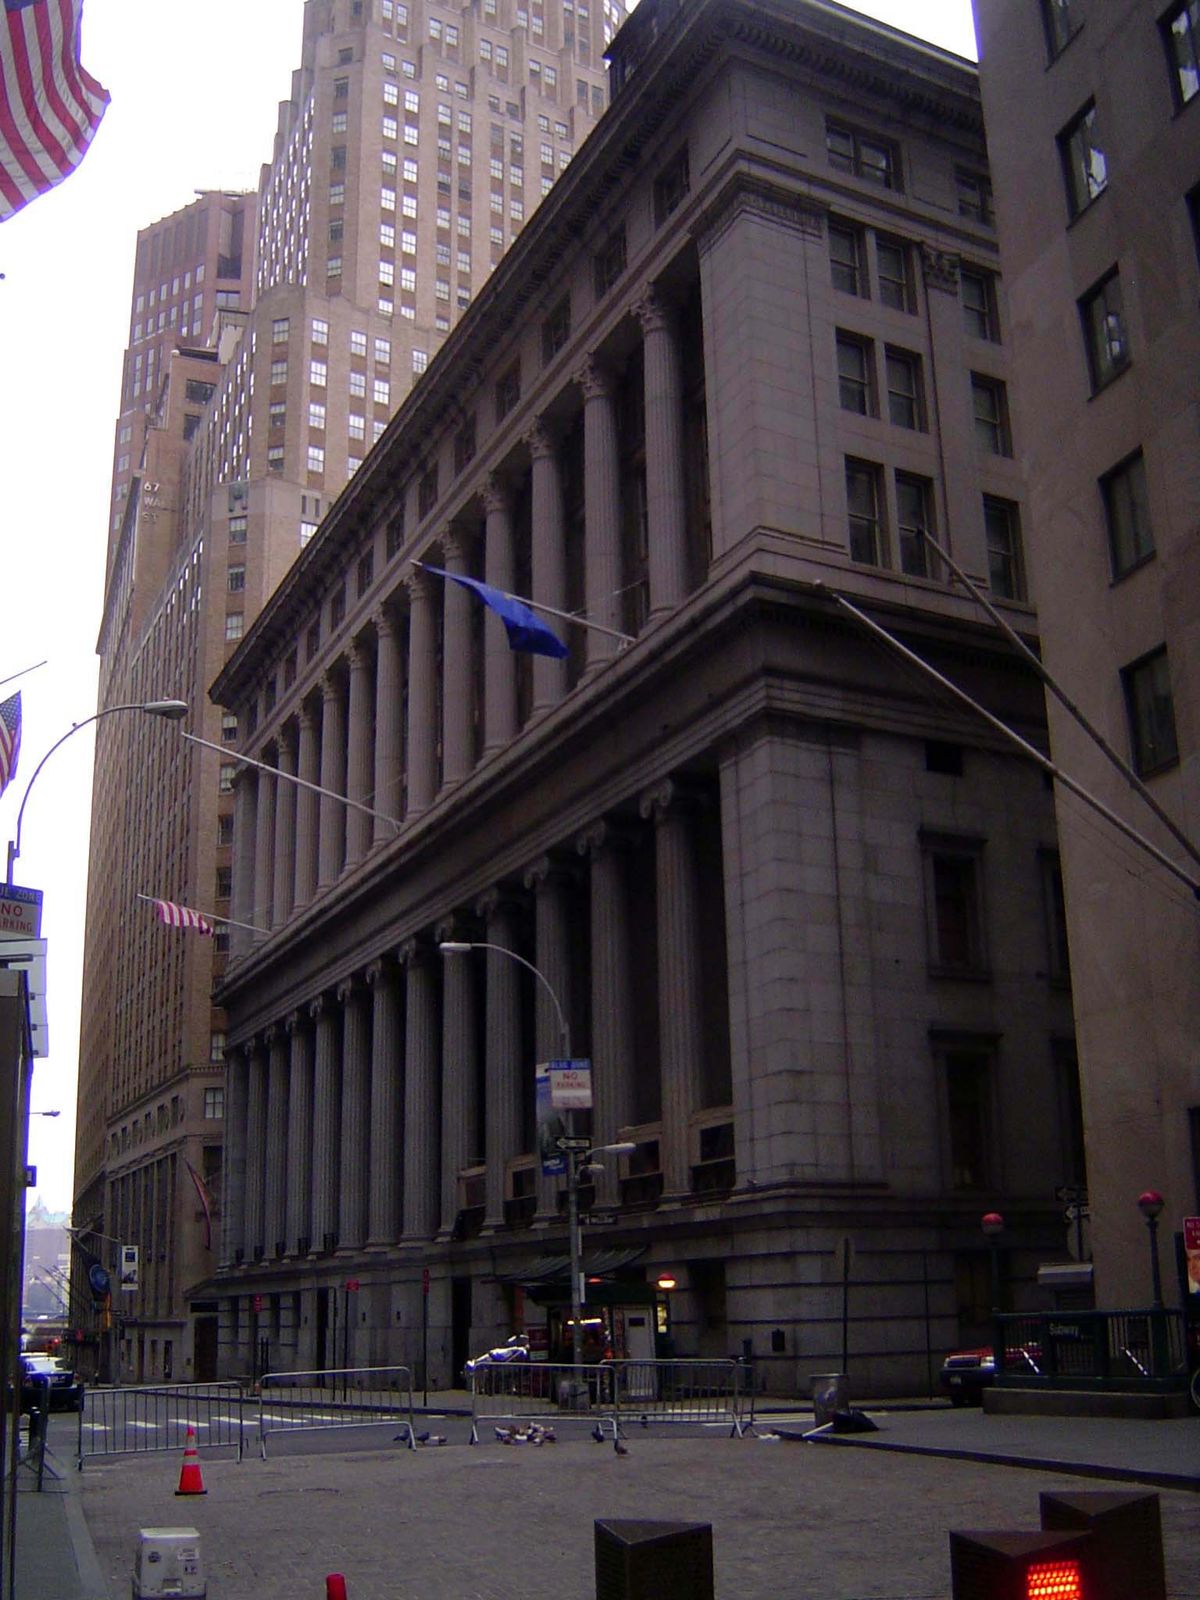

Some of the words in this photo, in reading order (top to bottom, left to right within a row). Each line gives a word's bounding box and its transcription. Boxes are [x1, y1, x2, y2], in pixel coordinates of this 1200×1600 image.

[144, 481, 160, 492] 67
[16, 889, 40, 903] ZONE
[0, 902, 23, 917] NO
[562, 1071, 578, 1080] NO
